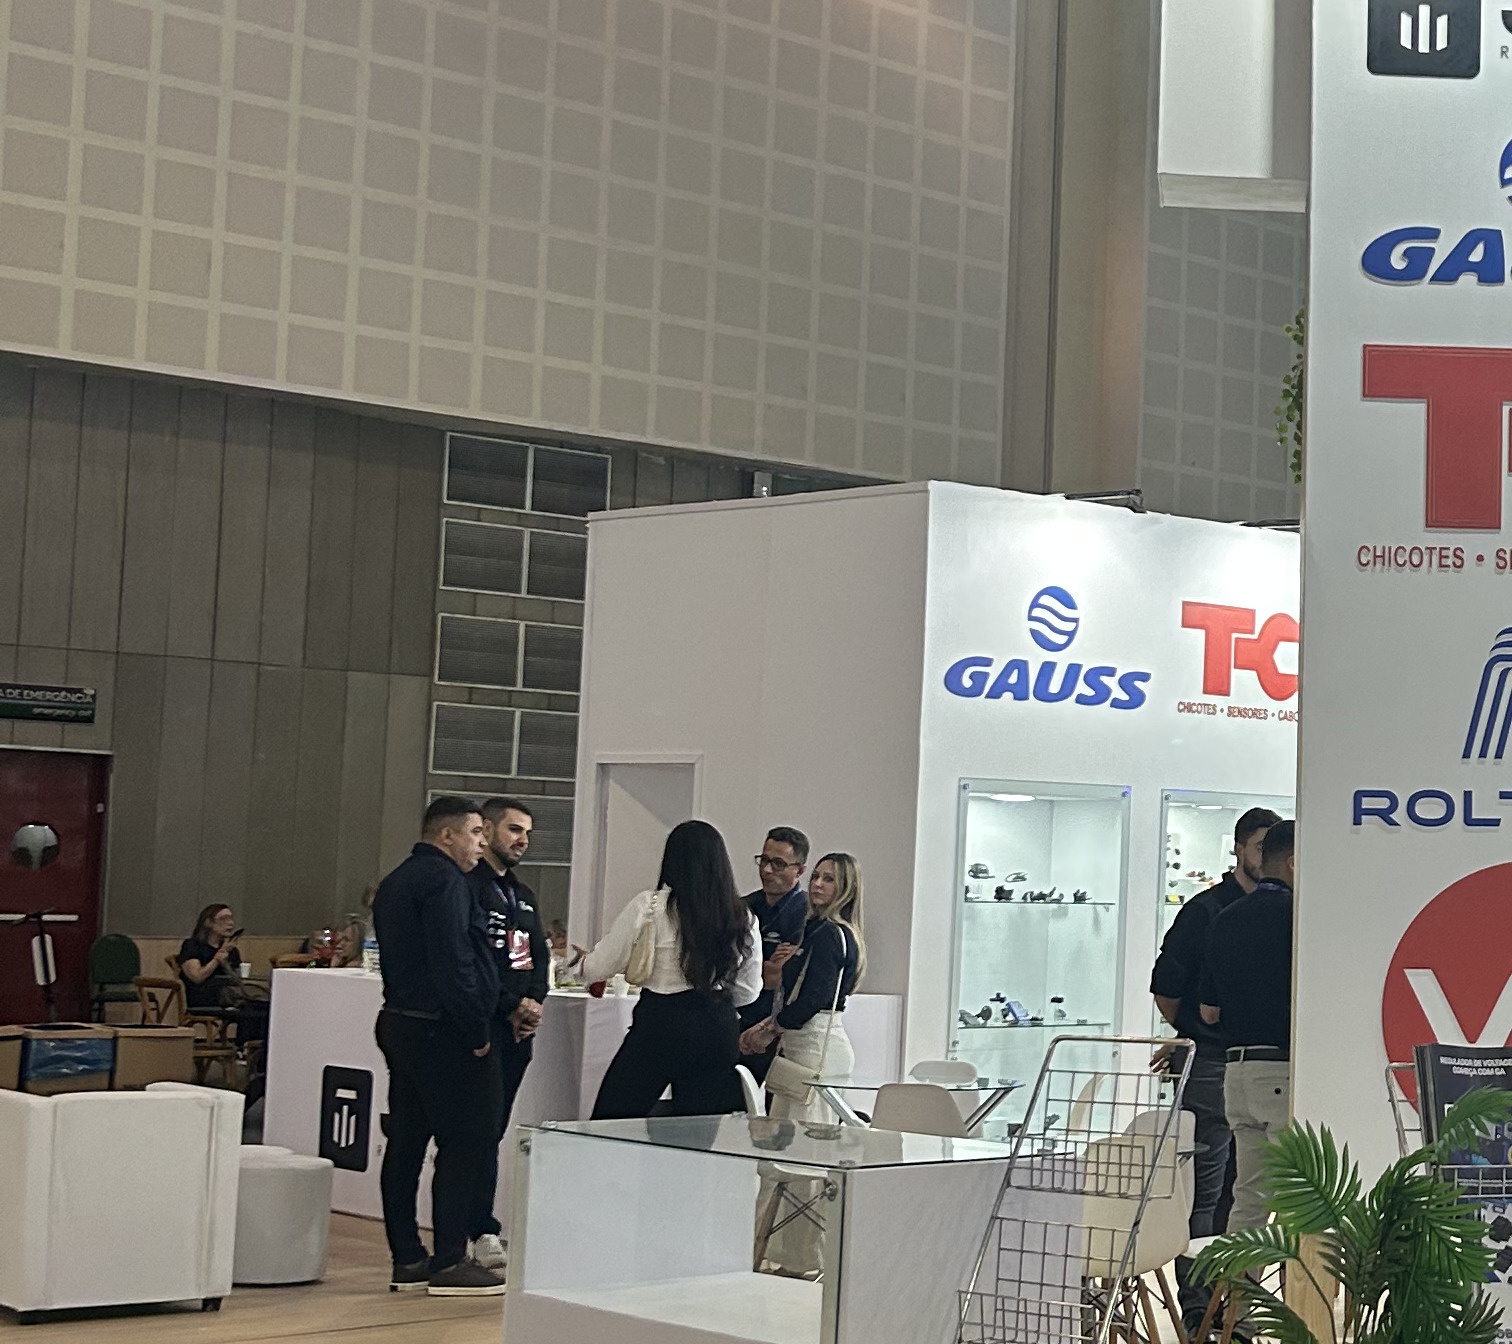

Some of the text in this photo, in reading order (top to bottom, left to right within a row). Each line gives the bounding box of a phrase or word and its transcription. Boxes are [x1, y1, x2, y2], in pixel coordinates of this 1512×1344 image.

[1357, 545, 1465, 570] CHICOTES
[943, 656, 1152, 711] GAUSS
[1177, 701, 1218, 716] CHICOTES
[1227, 705, 1269, 721] SENSORES
